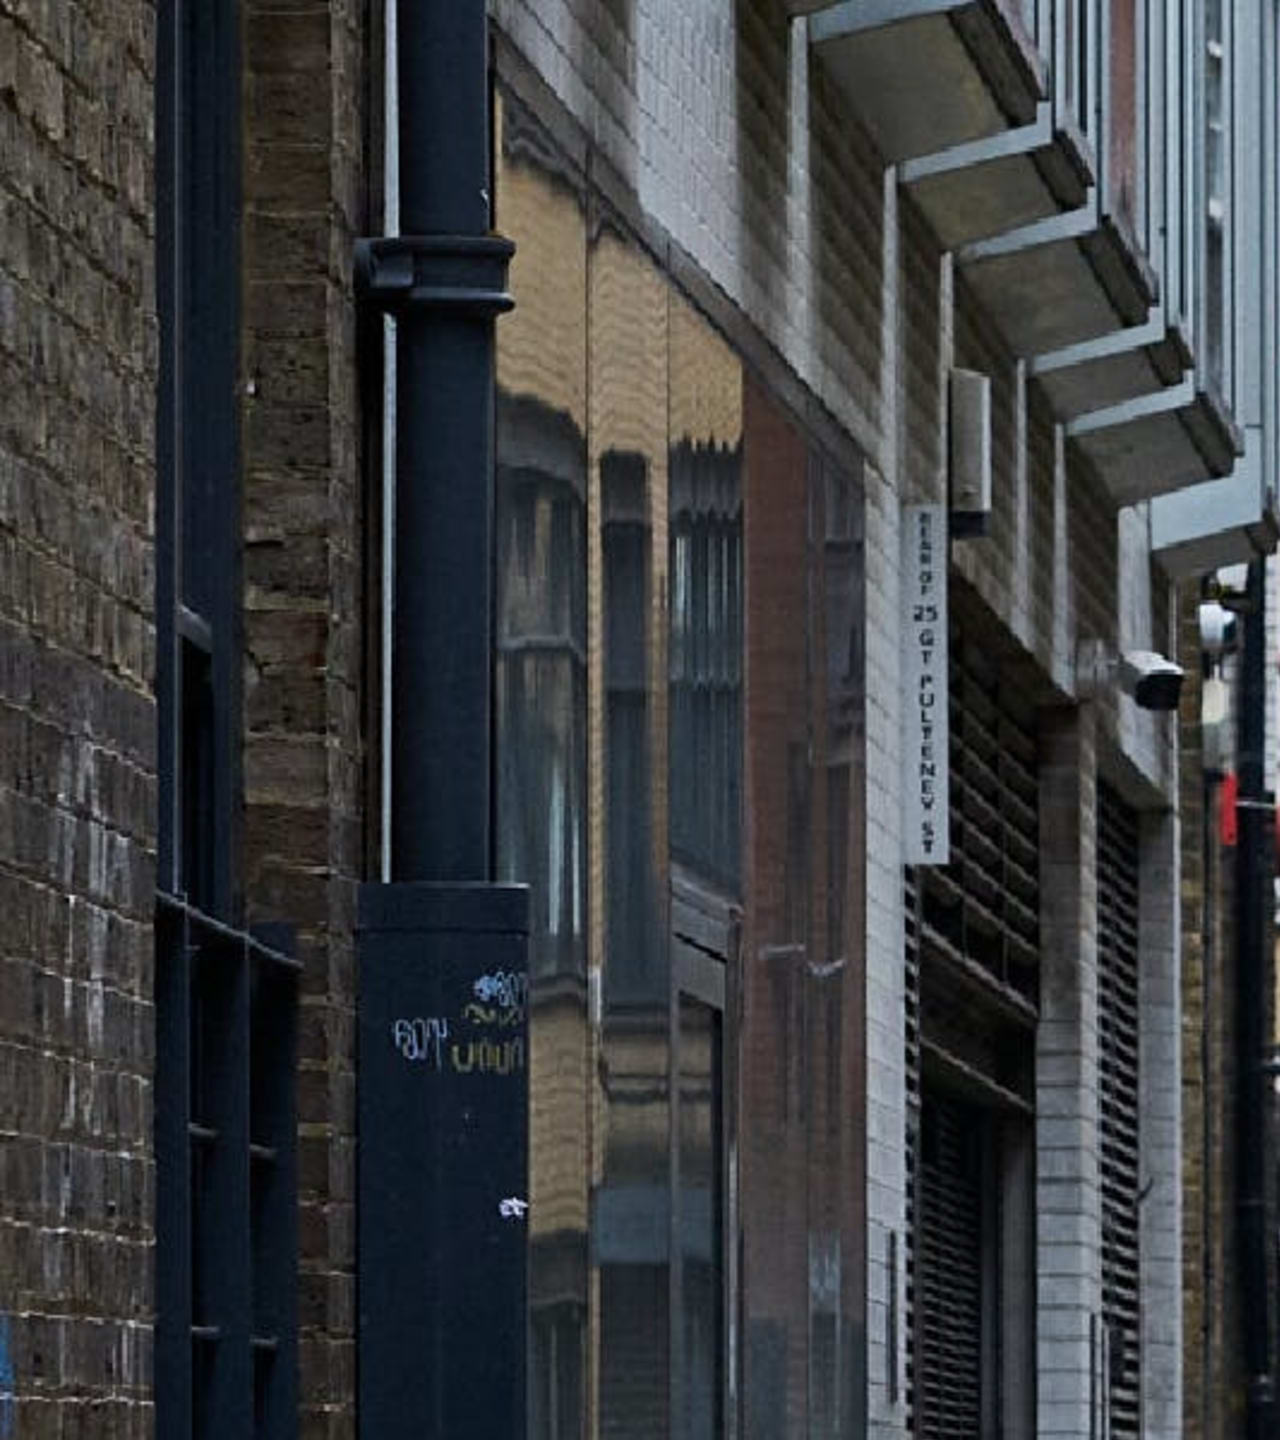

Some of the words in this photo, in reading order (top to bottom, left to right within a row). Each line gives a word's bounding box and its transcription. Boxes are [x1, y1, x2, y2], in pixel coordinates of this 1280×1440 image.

[912, 604, 938, 622] 25
[918, 628, 934, 664] GT
[919, 674, 936, 810] PULTENEY
[921, 820, 935, 854] ST
